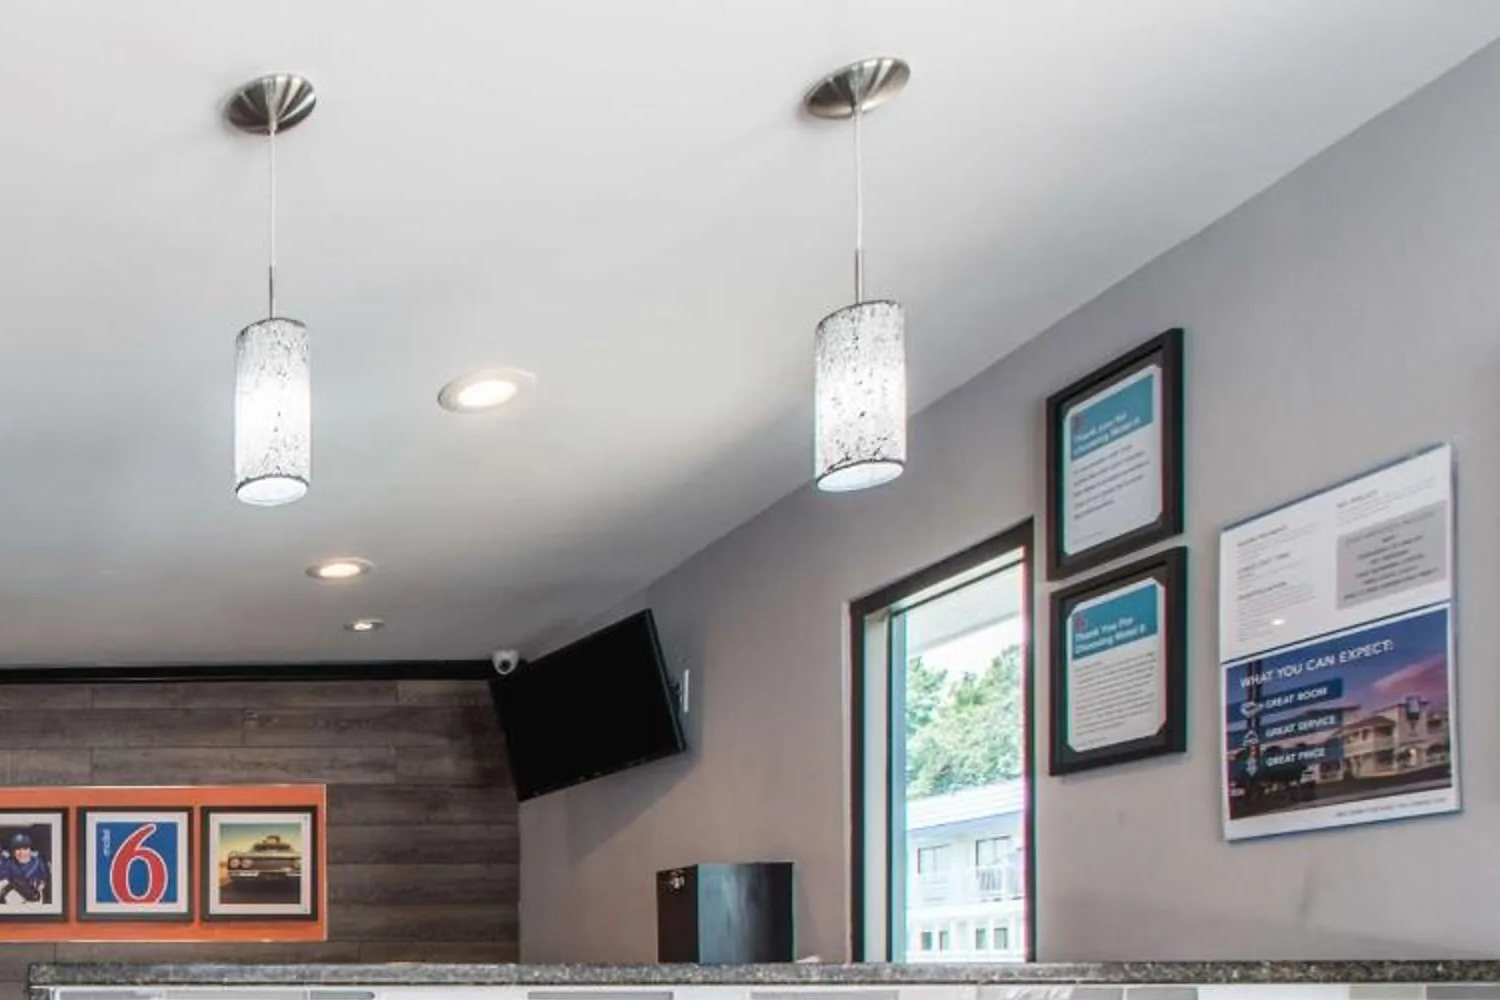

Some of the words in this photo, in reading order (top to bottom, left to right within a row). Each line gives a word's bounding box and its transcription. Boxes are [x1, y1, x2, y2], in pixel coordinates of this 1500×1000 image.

[1240, 670, 1273, 689] WHAT
[1277, 662, 1303, 679] YOU
[1305, 654, 1336, 672] CAN
[1265, 694, 1295, 709] GREAT
[1297, 686, 1328, 702] ROOM
[1265, 723, 1296, 738] GREAT
[1299, 715, 1336, 731] SERVICE
[1266, 752, 1296, 766] GREAT
[1298, 746, 1326, 761] PRICE
[109, 823, 169, 906] 6
